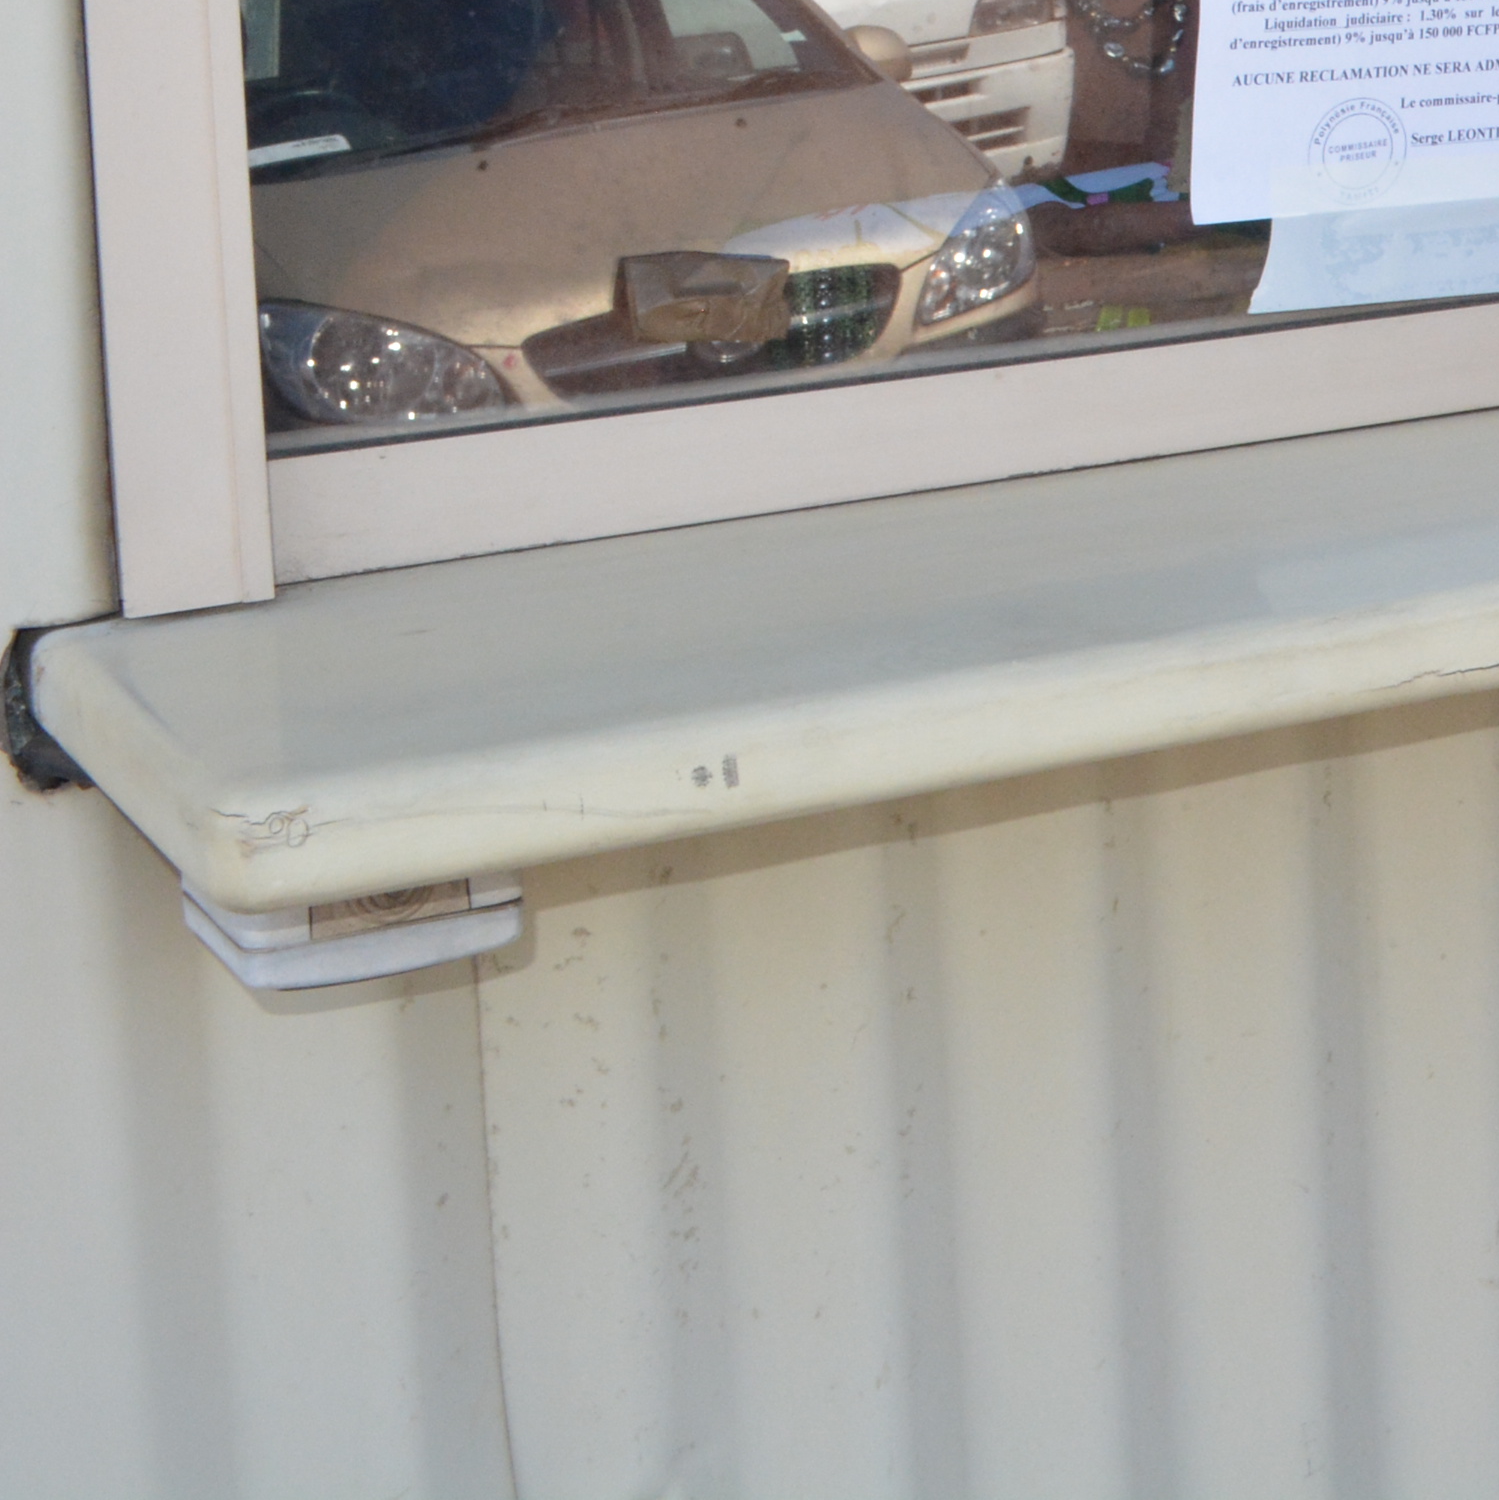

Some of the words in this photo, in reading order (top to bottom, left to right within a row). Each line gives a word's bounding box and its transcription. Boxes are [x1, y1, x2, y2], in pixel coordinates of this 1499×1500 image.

[1264, 15, 1337, 33] Liquidation
[1346, 11, 1404, 29] judiciaire
[1464, 9, 1484, 19] sur
[1345, 31, 1366, 43] 9%
[1419, 27, 1439, 40] 150
[1442, 25, 1463, 38] 000
[1233, 71, 1295, 87] AUCUNE
[1299, 64, 1408, 83] RECLAMATION
[1413, 63, 1431, 76] NE
[1435, 61, 1471, 74] SERA
[1400, 97, 1416, 109] Le
[1328, 138, 1388, 154] COMMISSAIRE
[1411, 133, 1444, 146] Serge
[1339, 150, 1377, 162] PRISEUR
